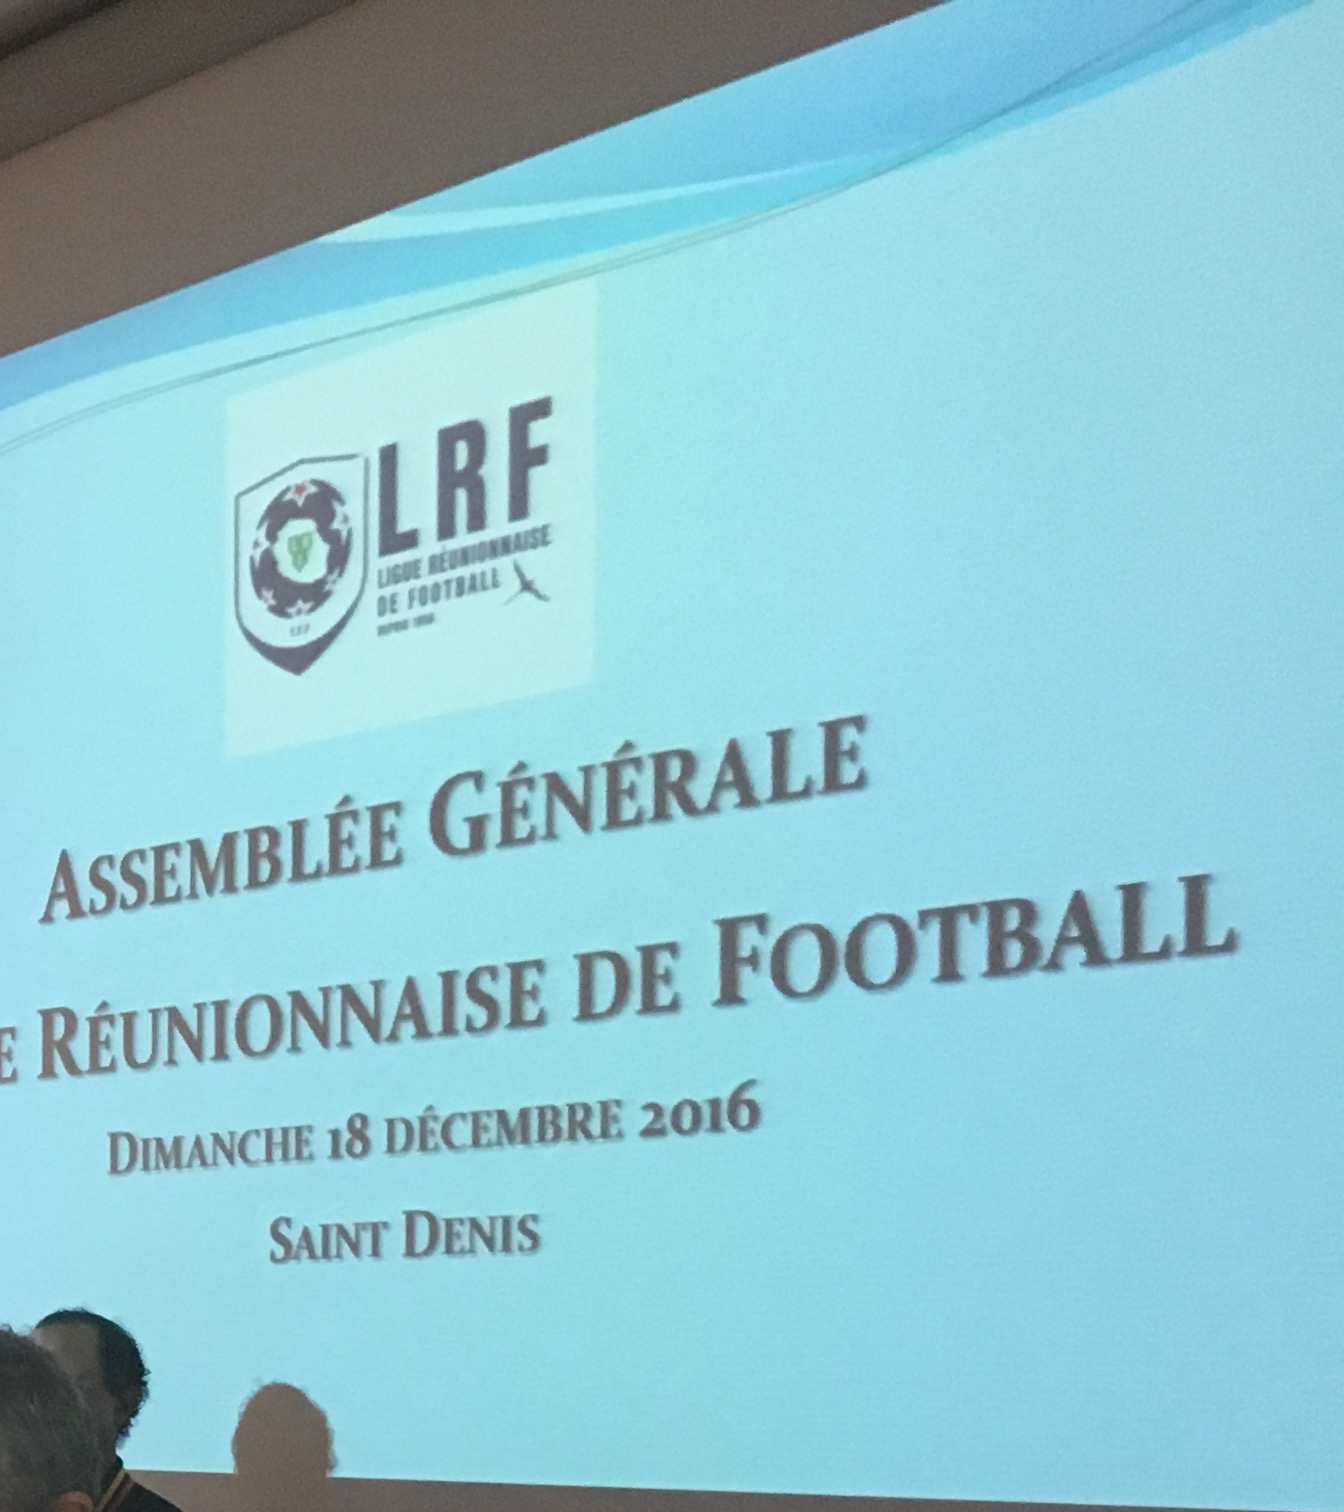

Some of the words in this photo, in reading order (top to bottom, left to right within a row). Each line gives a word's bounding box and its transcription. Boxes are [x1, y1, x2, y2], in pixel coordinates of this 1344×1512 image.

[378, 396, 552, 557] LRF
[377, 557, 422, 589] LIGUE
[377, 592, 399, 617] DE
[408, 566, 501, 610] FOOTBALL
[328, 1112, 372, 1160] 18
[639, 1078, 761, 1137] 2016
